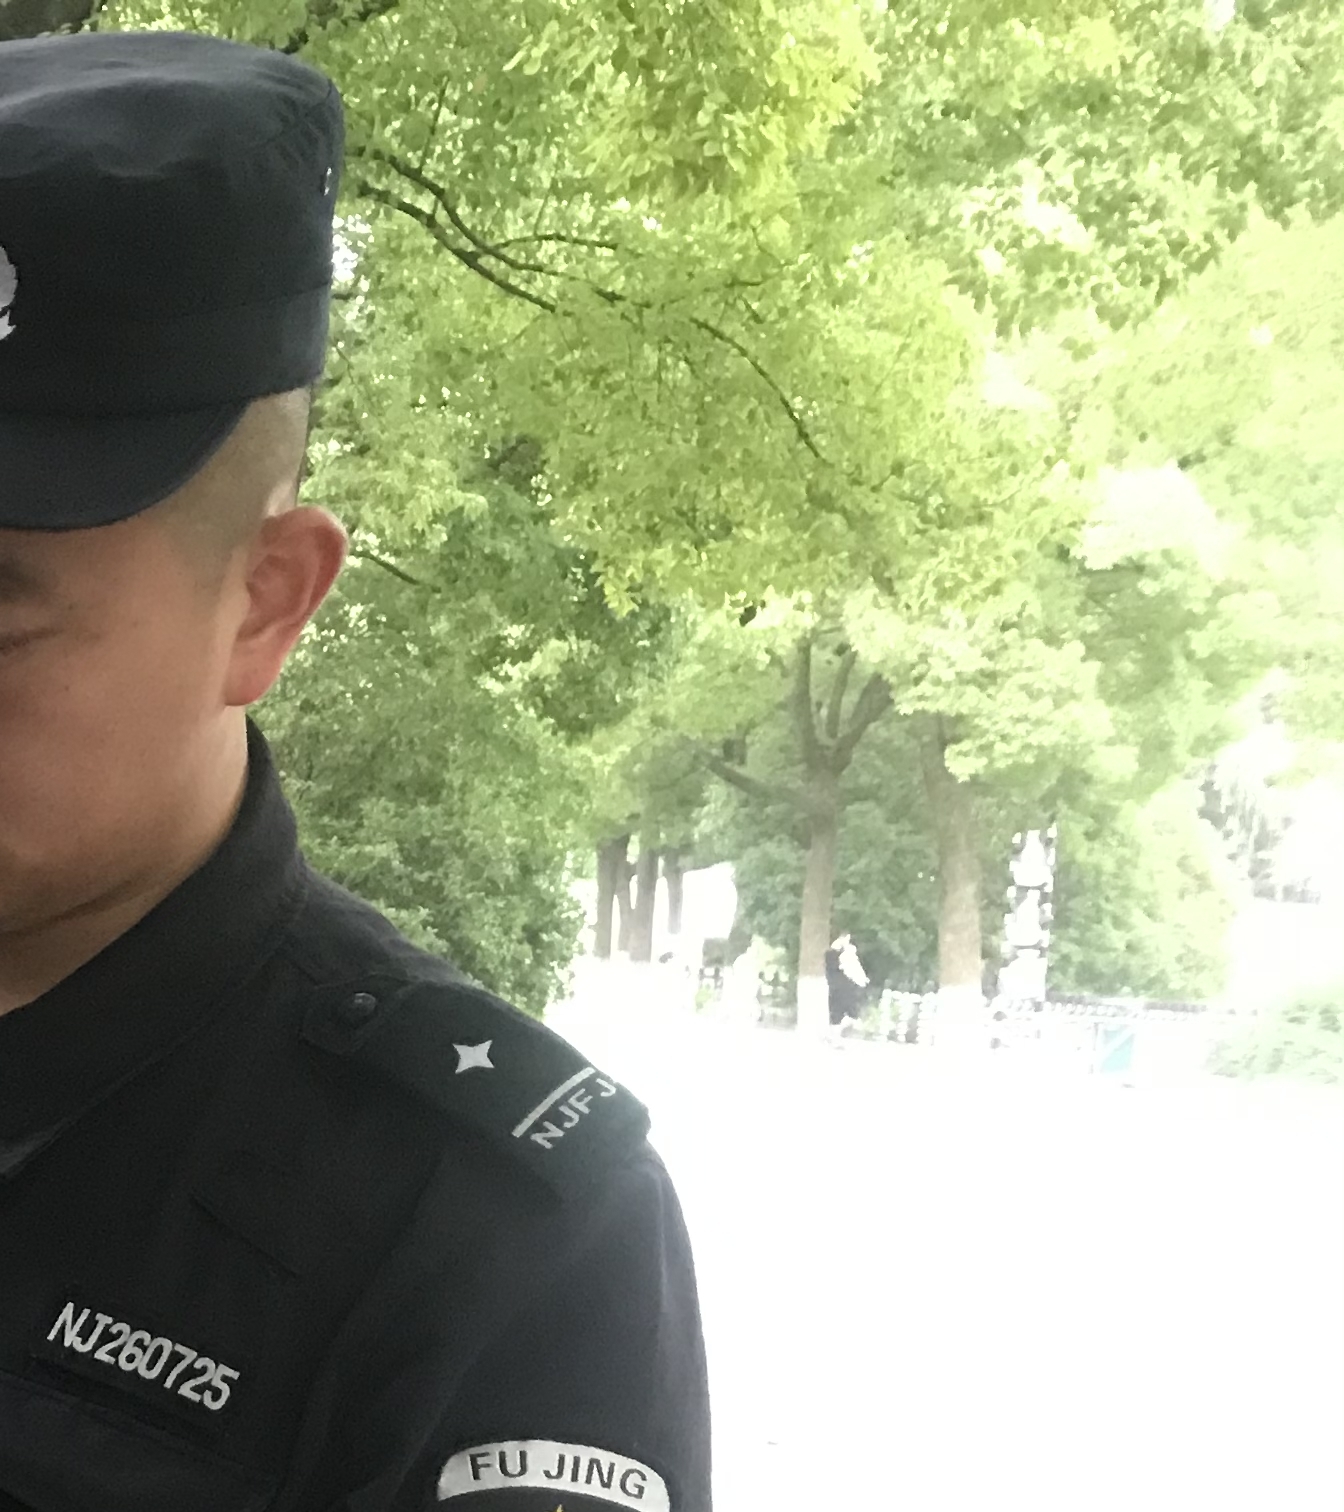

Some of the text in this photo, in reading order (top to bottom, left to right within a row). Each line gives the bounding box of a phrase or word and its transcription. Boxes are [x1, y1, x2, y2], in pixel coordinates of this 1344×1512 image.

[529, 1077, 617, 1150] NJFJ
[47, 1301, 241, 1411] NJ260725
[469, 1450, 649, 1502] FU JING
